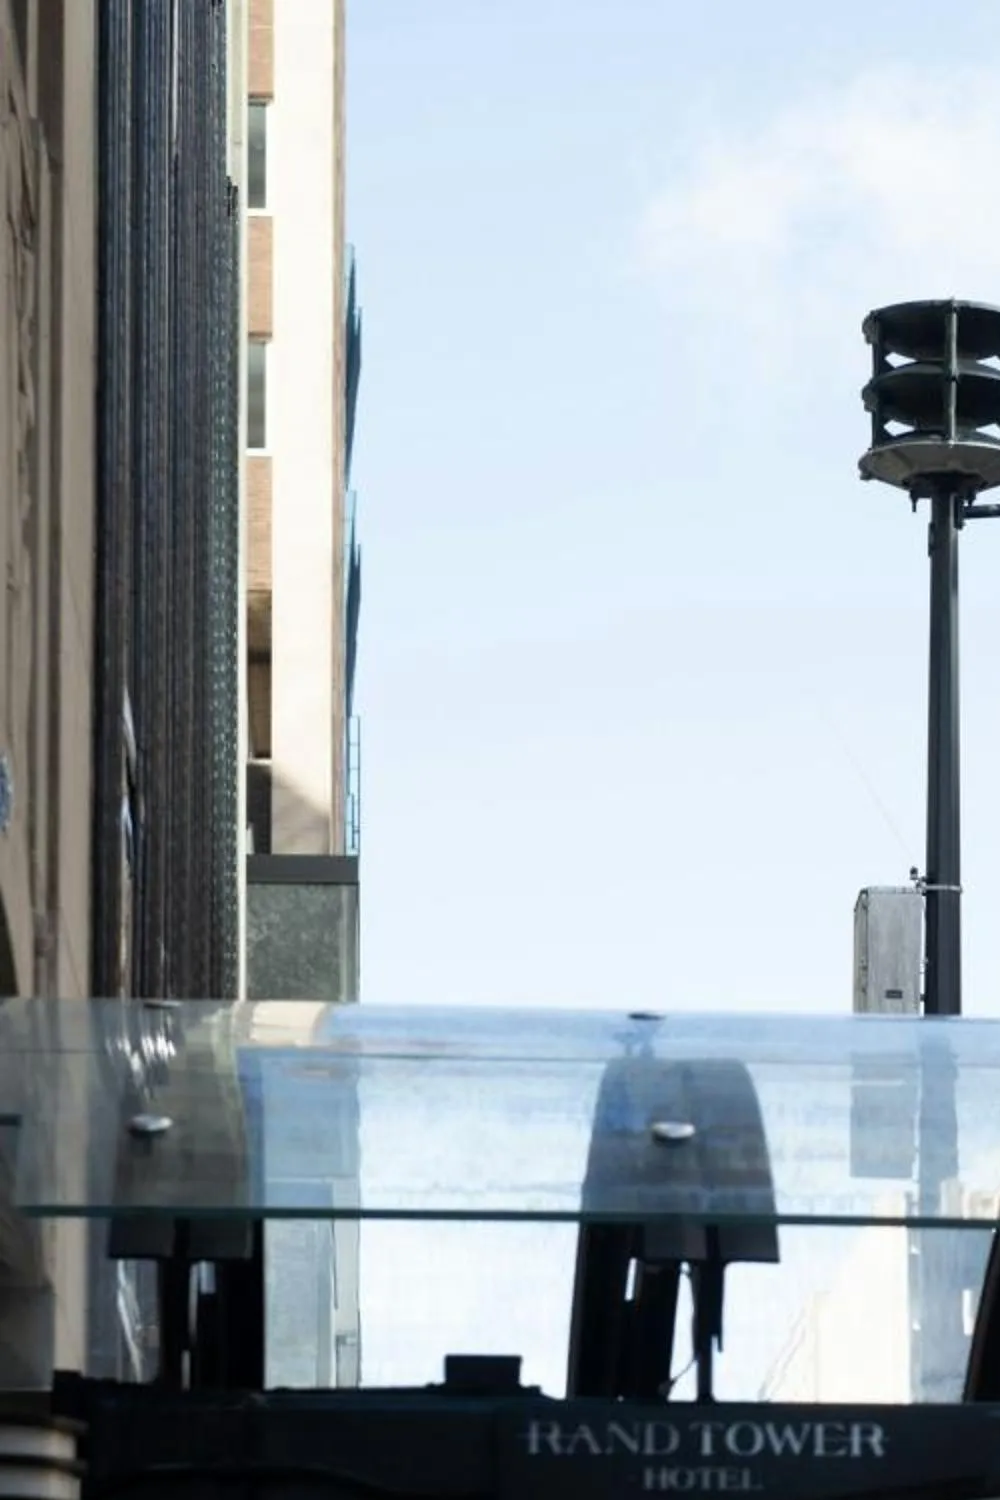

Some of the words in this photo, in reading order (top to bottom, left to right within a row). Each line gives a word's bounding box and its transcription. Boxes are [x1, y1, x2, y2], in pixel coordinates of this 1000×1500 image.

[526, 1420, 681, 1457] RAND
[689, 1420, 886, 1459] TOWER
[642, 1466, 763, 1492] HOTEL
